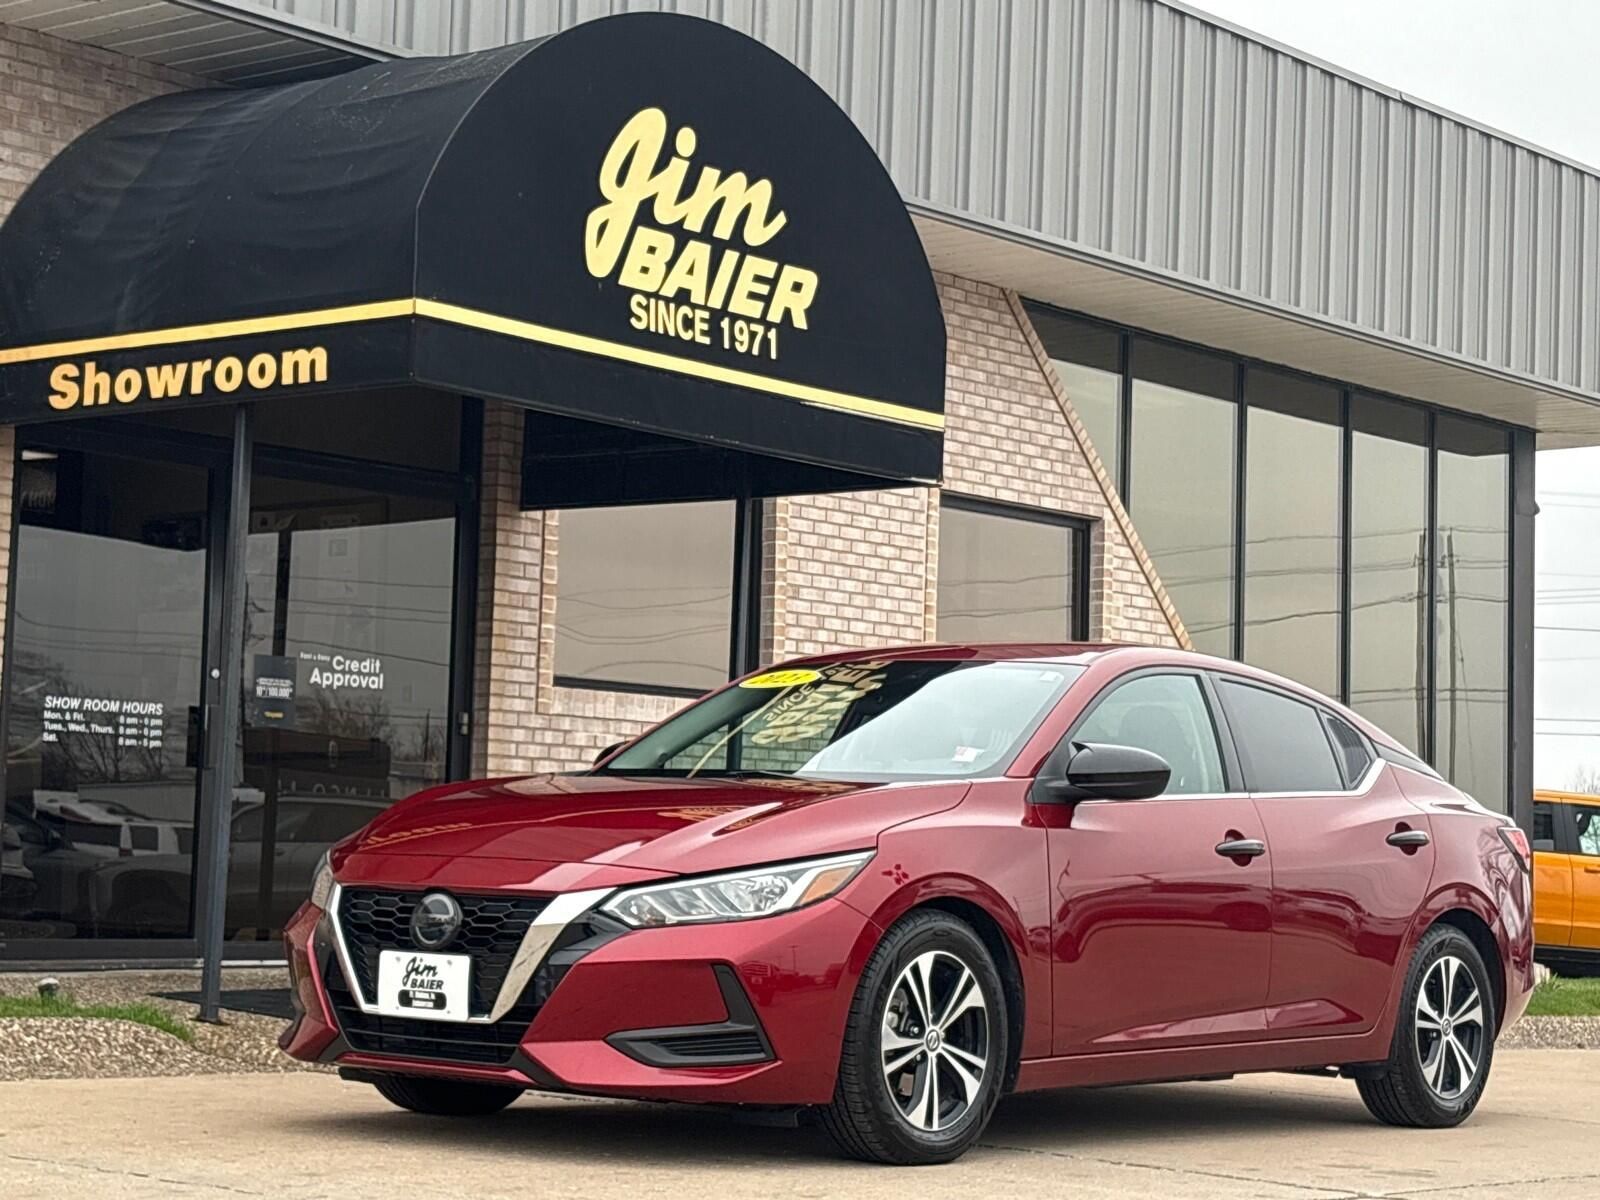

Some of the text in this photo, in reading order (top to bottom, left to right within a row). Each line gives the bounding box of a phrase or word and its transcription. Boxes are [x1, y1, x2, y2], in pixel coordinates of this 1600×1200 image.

[585, 107, 787, 278] Jim
[618, 225, 818, 330] BAIER
[630, 293, 777, 360] SINCE 1971
[48, 346, 328, 410] Showroom
[309, 667, 384, 690] Approval
[332, 655, 381, 674] Credit
[44, 695, 164, 716] SHOW ROOM HOURS
[402, 956, 438, 987] Jim
[410, 978, 444, 990] BAIER
